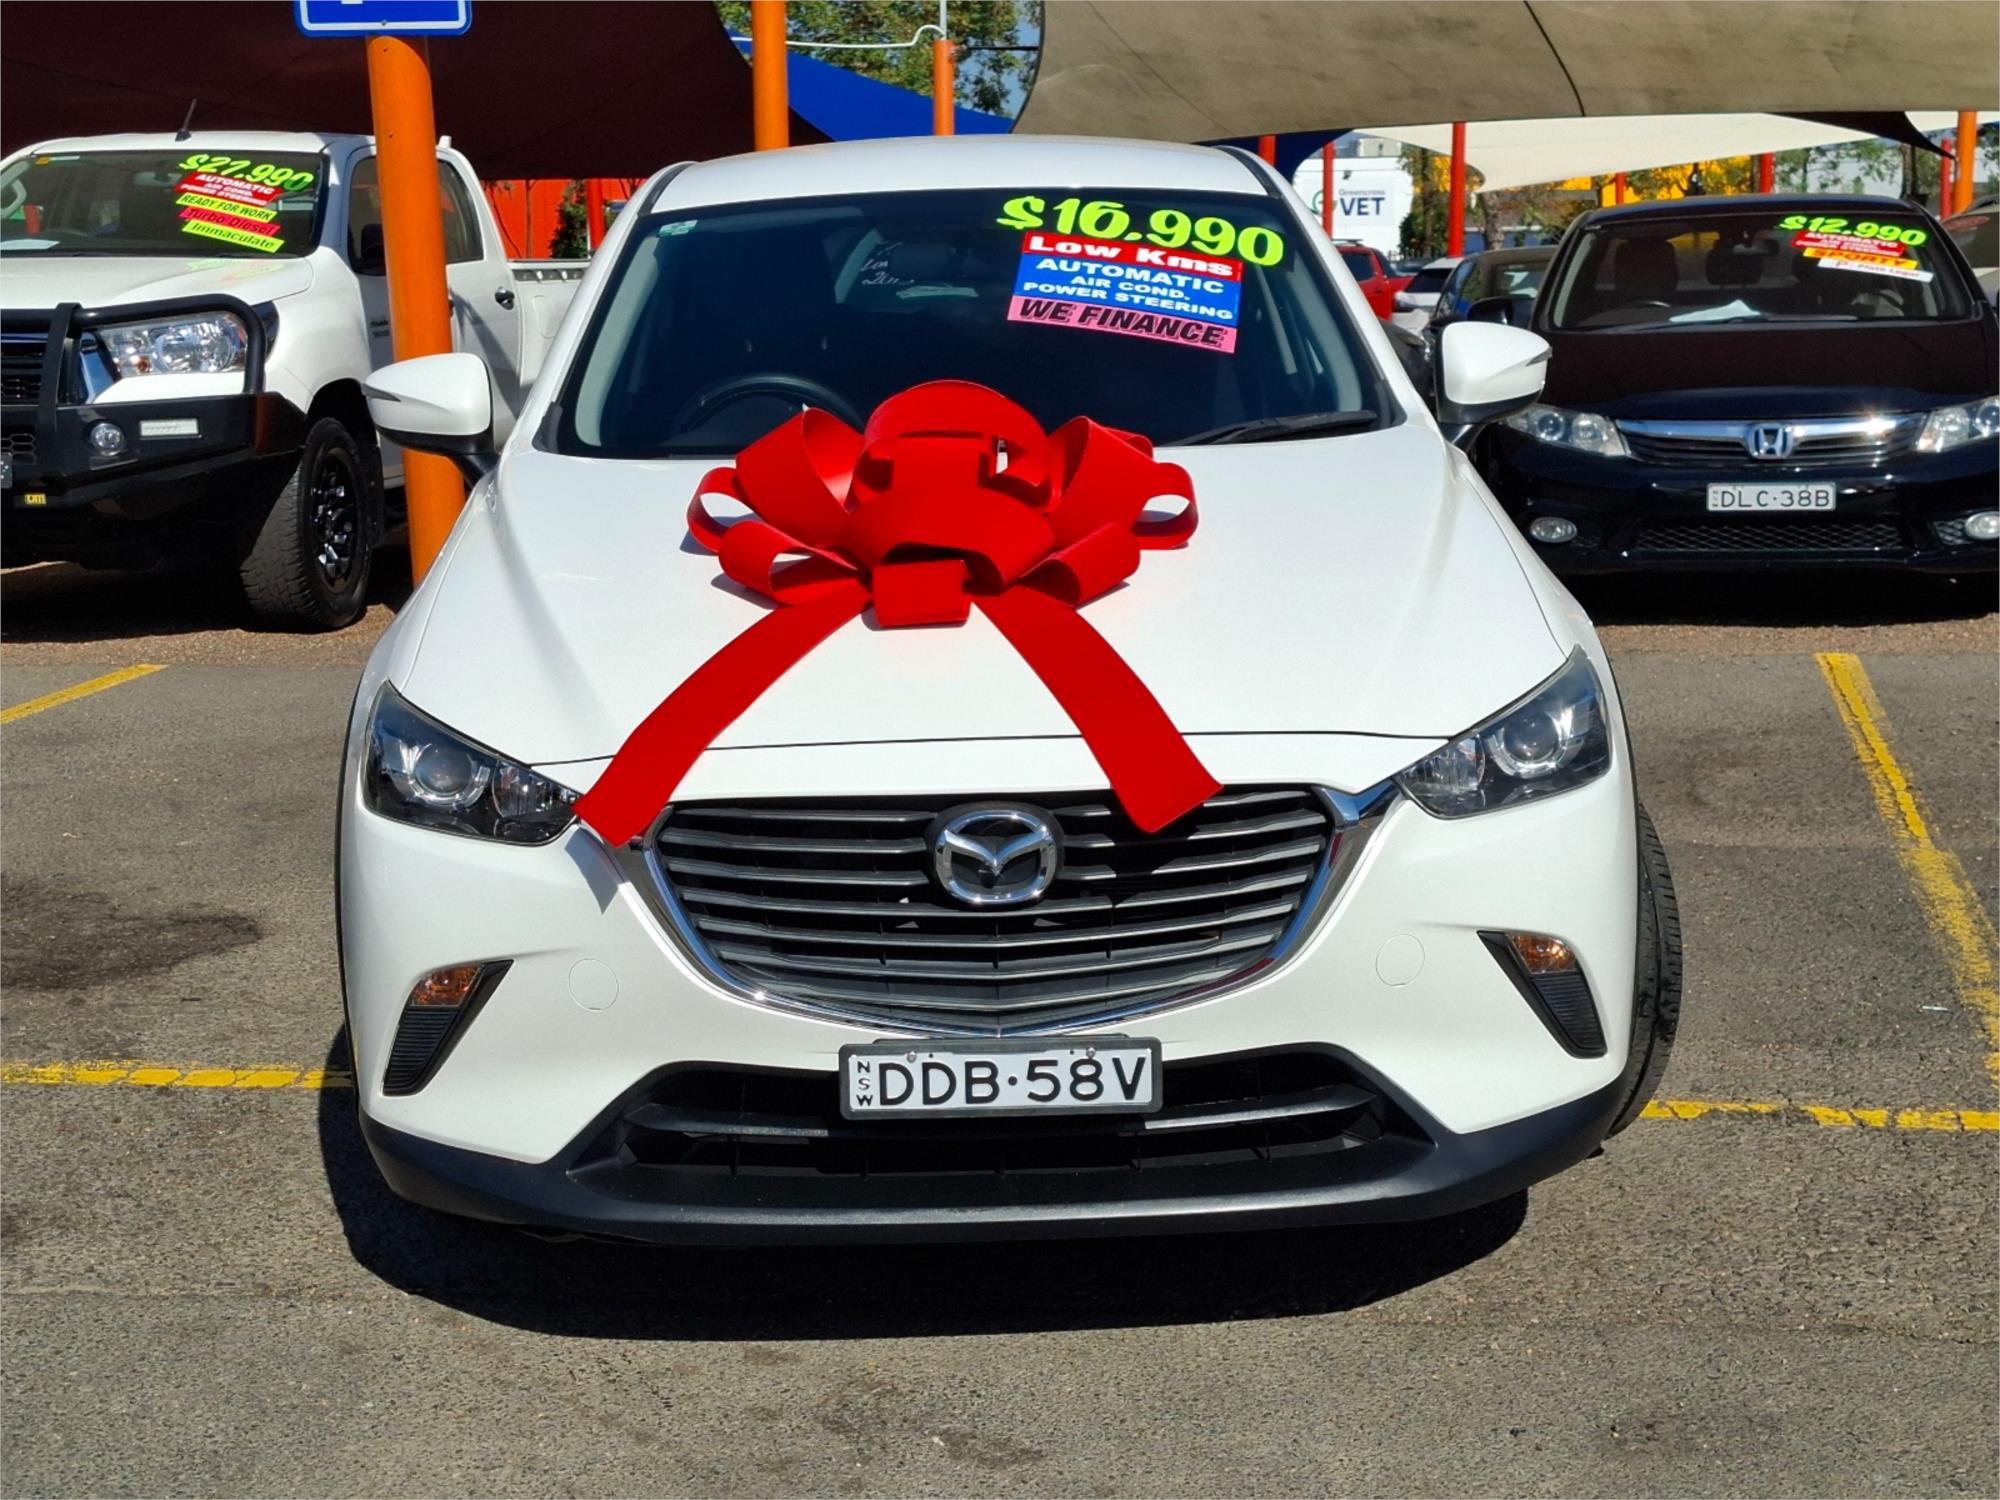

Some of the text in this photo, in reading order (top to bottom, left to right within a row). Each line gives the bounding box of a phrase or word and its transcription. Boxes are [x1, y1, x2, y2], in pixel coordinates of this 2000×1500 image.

[195, 174, 275, 194] AUTOMATIC
[182, 194, 273, 220] READY FOR WORK
[1340, 197, 1385, 216] VET
[187, 208, 275, 235] Turbo Diesel
[192, 222, 275, 248] Immaculate
[1804, 232, 1899, 248] AUTOMATIC
[1028, 235, 1233, 277] Low Kms
[1813, 249, 1907, 266] SPORTY
[1036, 258, 1224, 294] AUTOMATIC
[1070, 276, 1190, 300] AIR COND.
[1023, 282, 1233, 320] POWER STEERING
[1019, 298, 1228, 348] WE FINANCE
[856, 1061, 873, 1107] NSW
